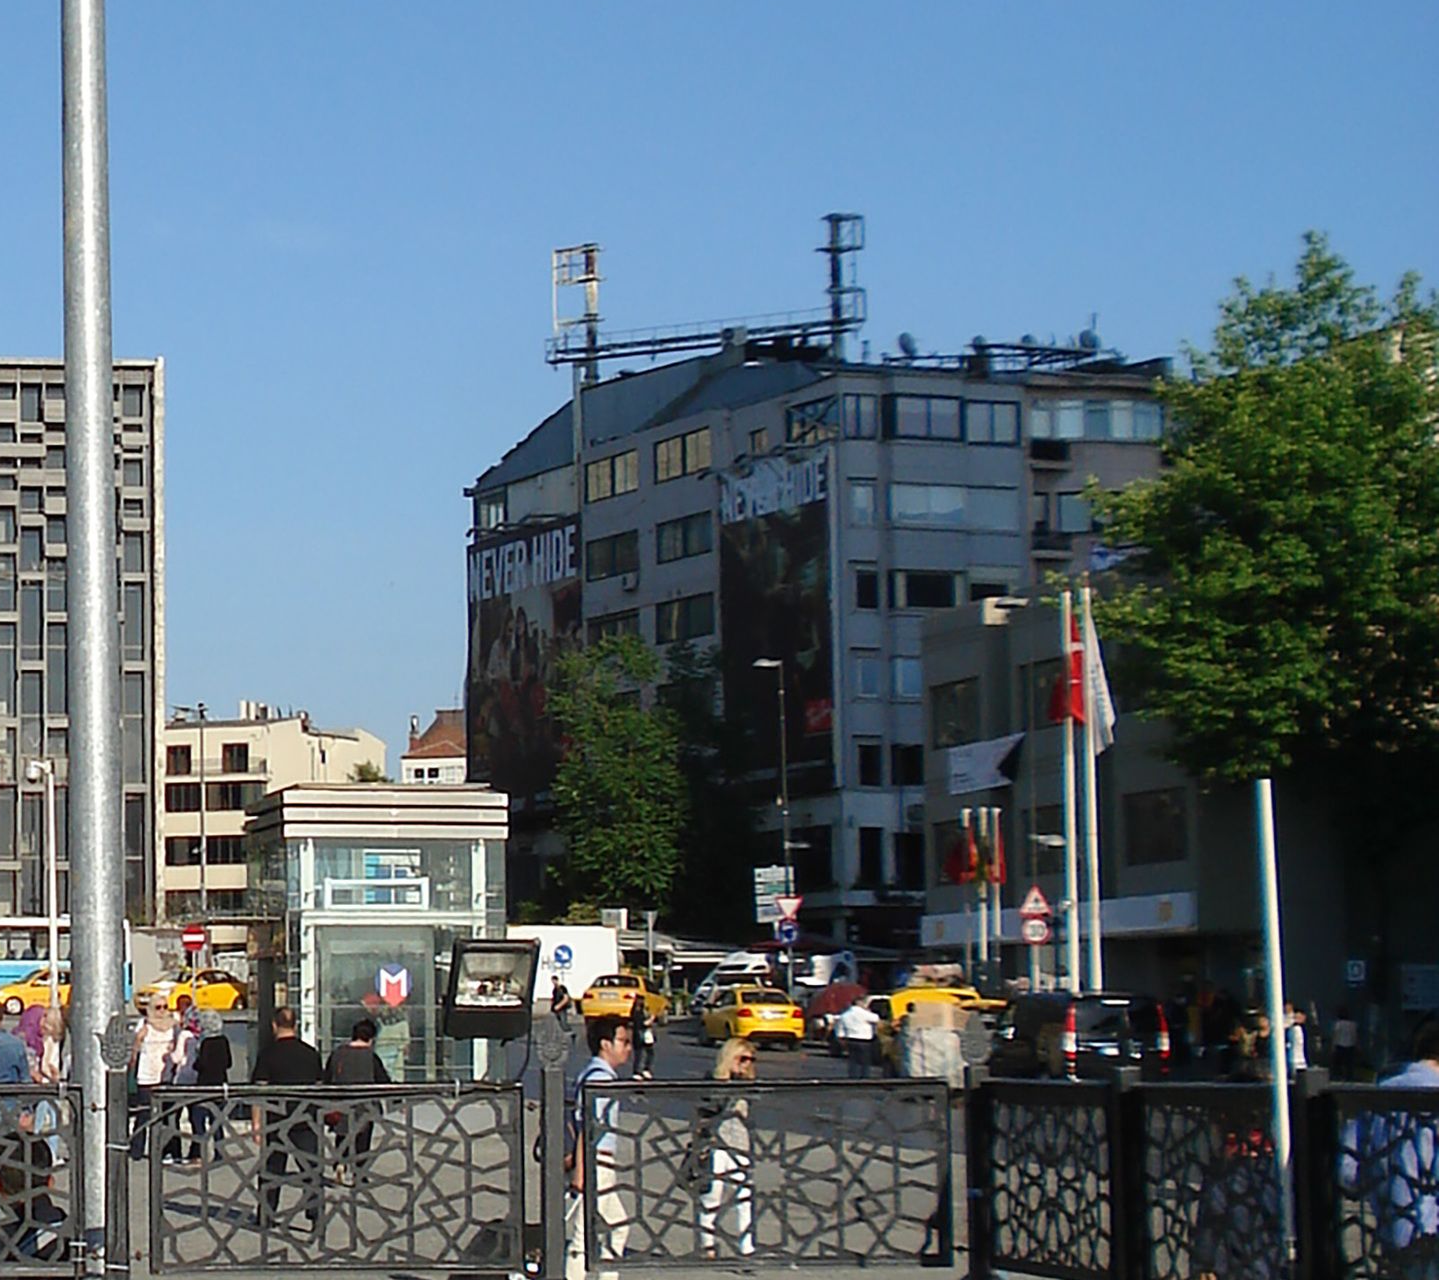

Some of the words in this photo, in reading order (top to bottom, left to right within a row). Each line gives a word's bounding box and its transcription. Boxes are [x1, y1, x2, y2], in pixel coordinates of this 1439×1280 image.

[720, 461, 779, 525] NEV
[469, 540, 529, 604] NEVER
[532, 524, 577, 587] HIDE
